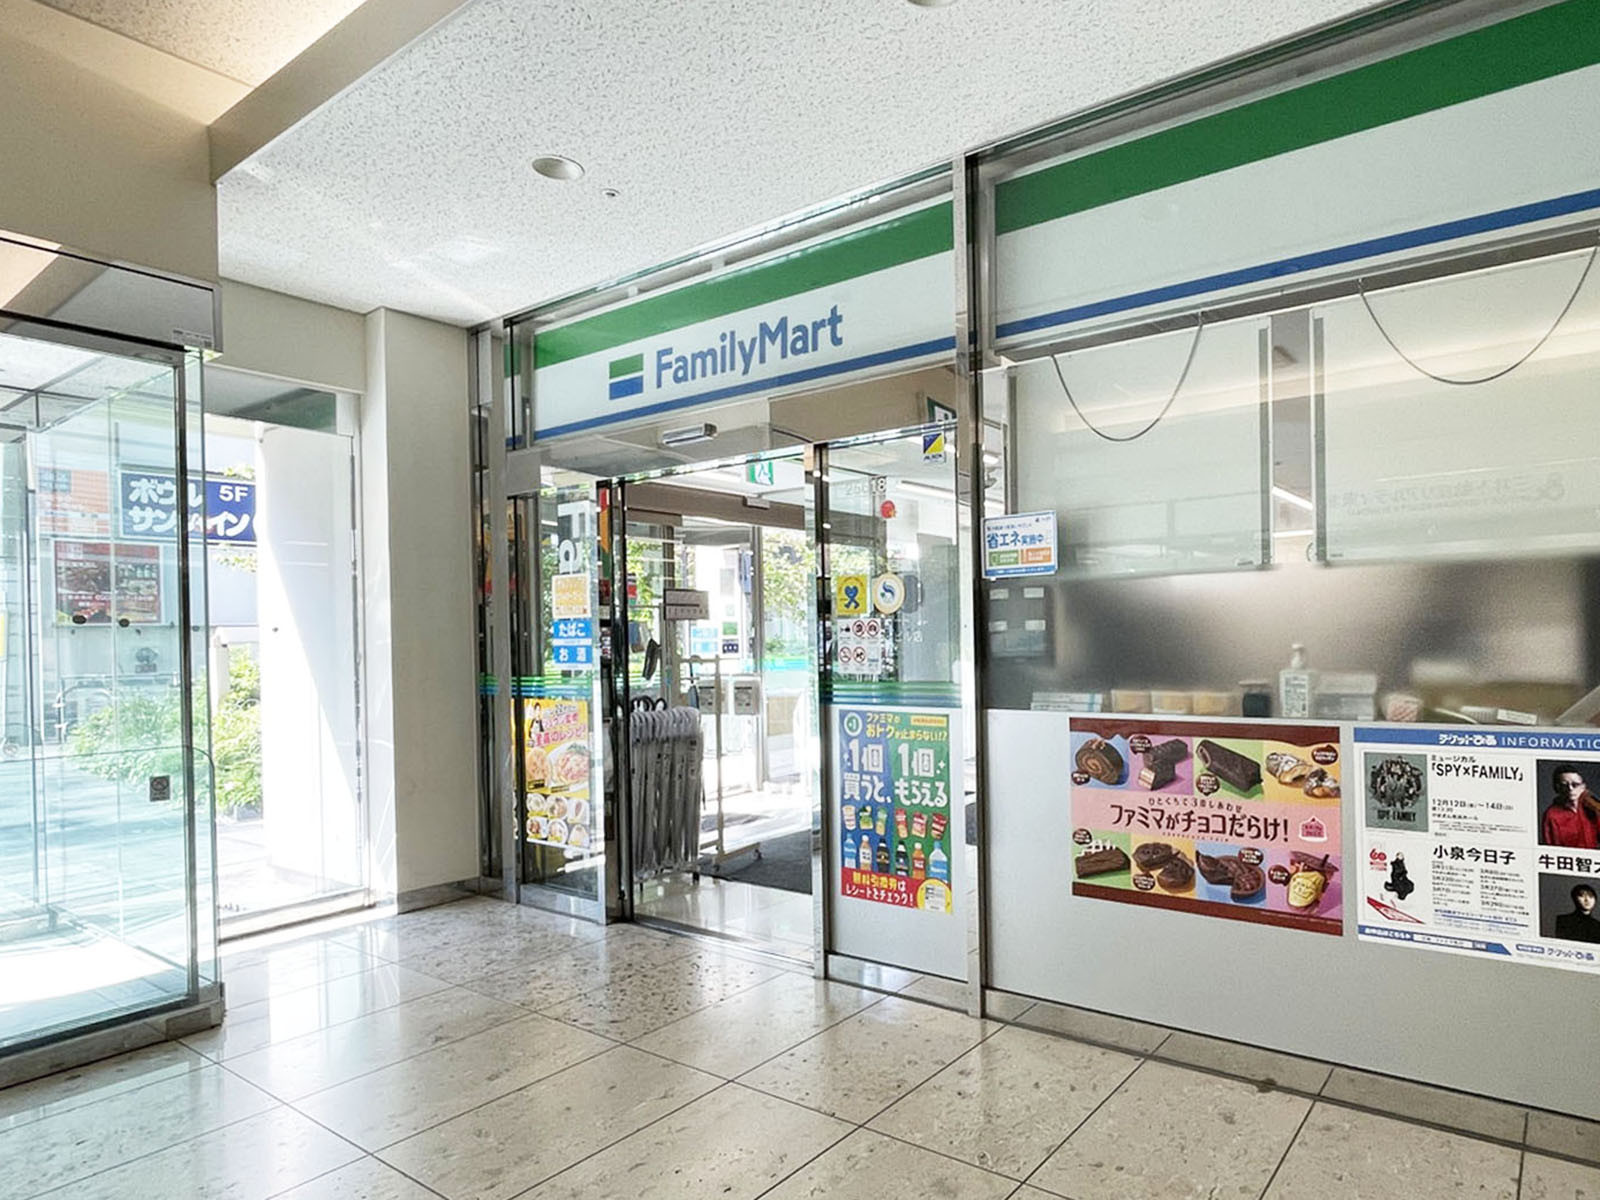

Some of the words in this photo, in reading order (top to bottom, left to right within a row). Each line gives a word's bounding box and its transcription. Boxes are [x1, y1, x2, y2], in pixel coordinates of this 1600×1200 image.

[656, 305, 843, 389] FamilyMart
[219, 485, 248, 502] 5F
[1439, 732, 1497, 746] チケットぴあ
[1432, 754, 1476, 763] ミュージカル
[894, 777, 948, 808] もらえる
[1110, 804, 1289, 842] ファミマがチョコだらけ!
[1433, 845, 1516, 865] 小泉今日子
